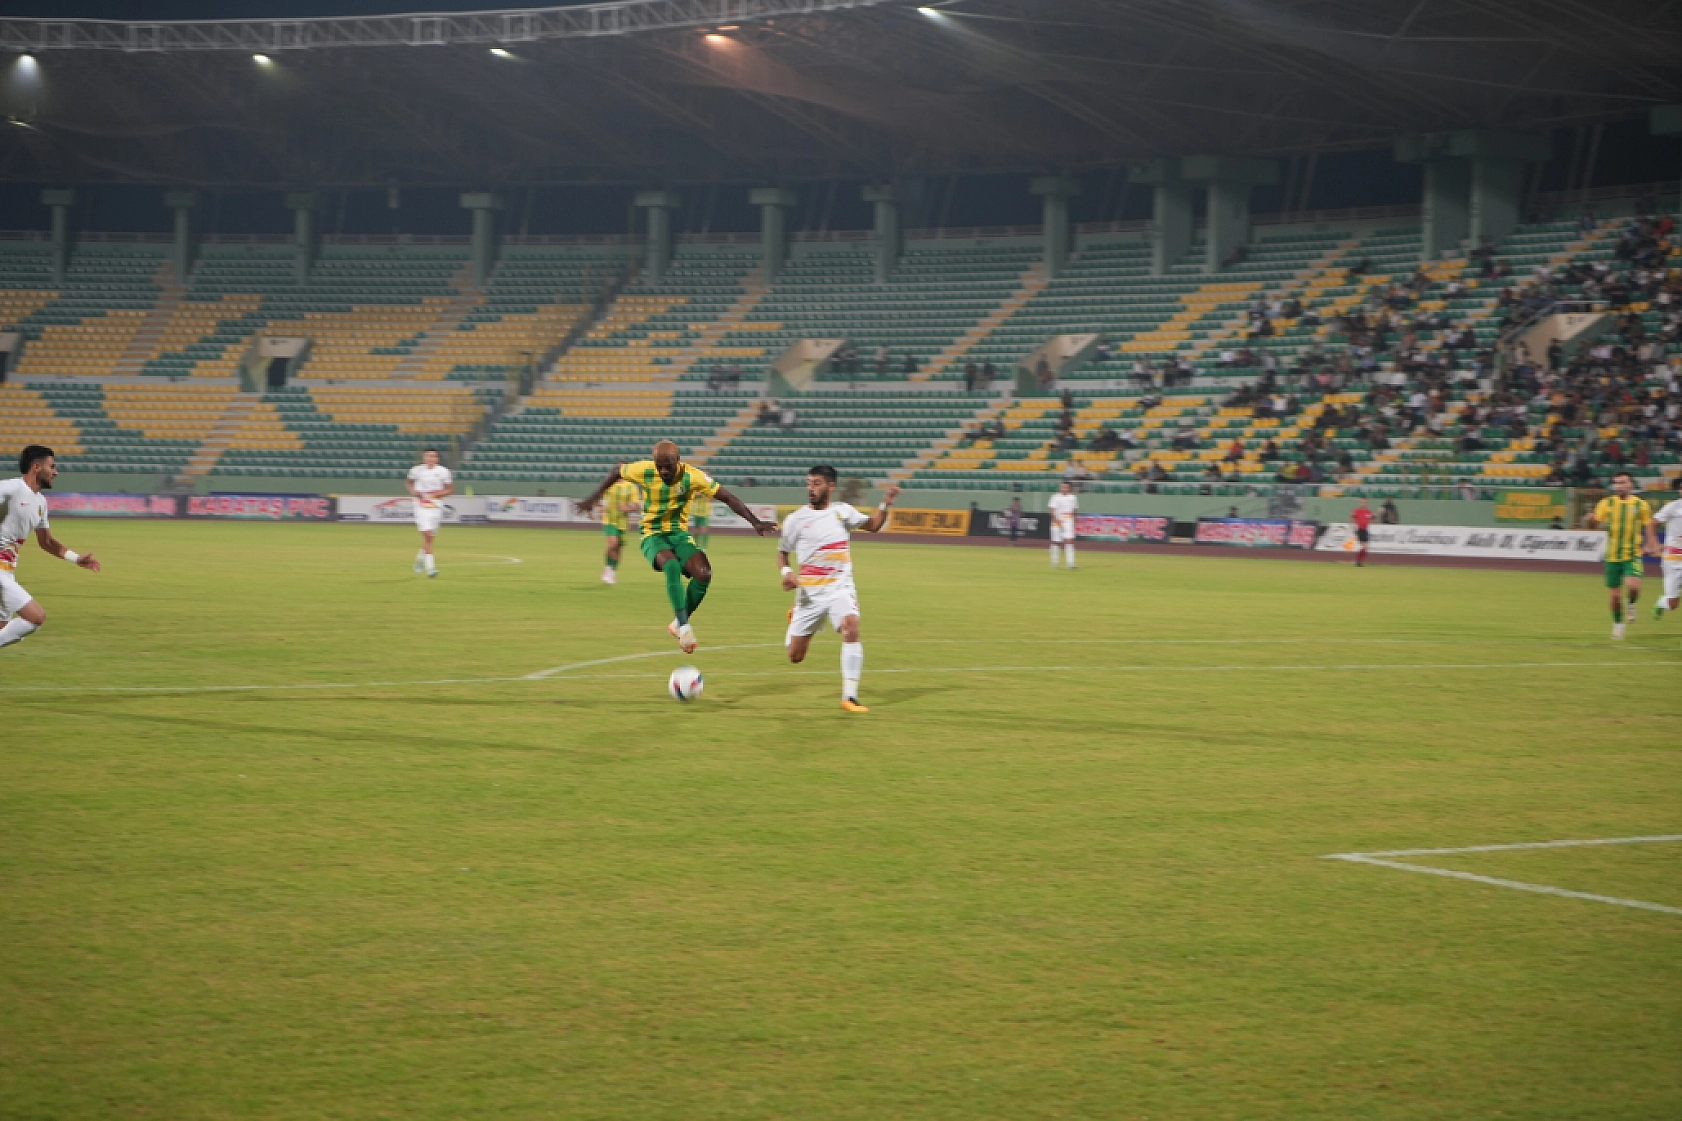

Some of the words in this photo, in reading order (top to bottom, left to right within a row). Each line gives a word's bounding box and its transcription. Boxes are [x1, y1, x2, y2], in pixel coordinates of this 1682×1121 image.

[187, 496, 283, 518] KARATAŞ
[287, 497, 331, 517] PVC
[1075, 516, 1129, 541] ARATAŞ
[1134, 517, 1168, 539] PVC
